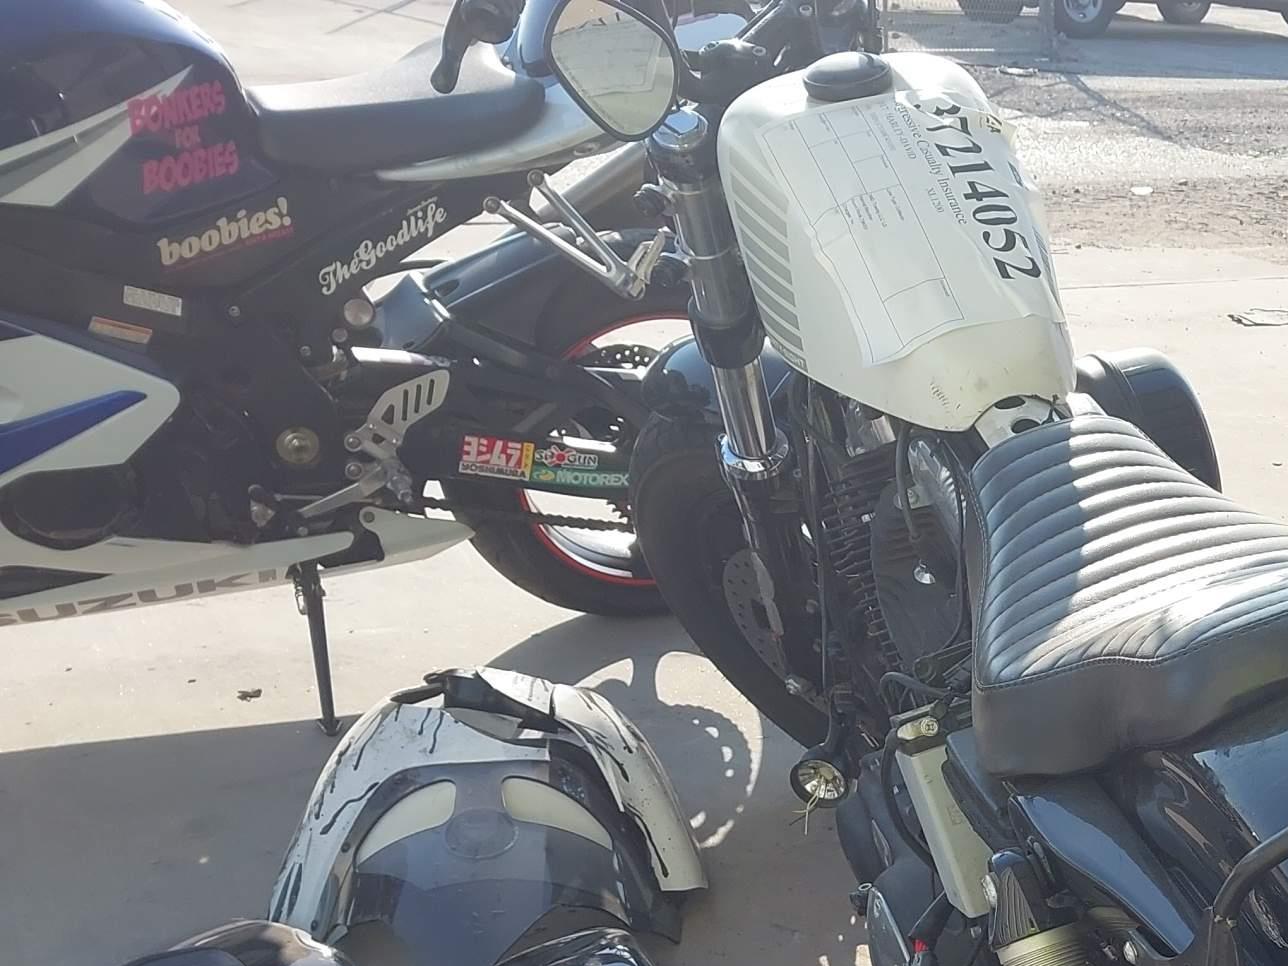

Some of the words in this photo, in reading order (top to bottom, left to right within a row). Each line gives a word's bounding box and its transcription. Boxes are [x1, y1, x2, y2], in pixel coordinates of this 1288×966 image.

[128, 80, 226, 135] BONKERS
[142, 141, 239, 194] BOOBIES
[914, 103, 1042, 281] 37214052
[937, 177, 968, 225] Insurance
[157, 196, 292, 266] boobies!
[461, 462, 527, 479] YOSHIMURA
[463, 435, 521, 467] ヨシムラ
[556, 469, 630, 486] MOTOREX
